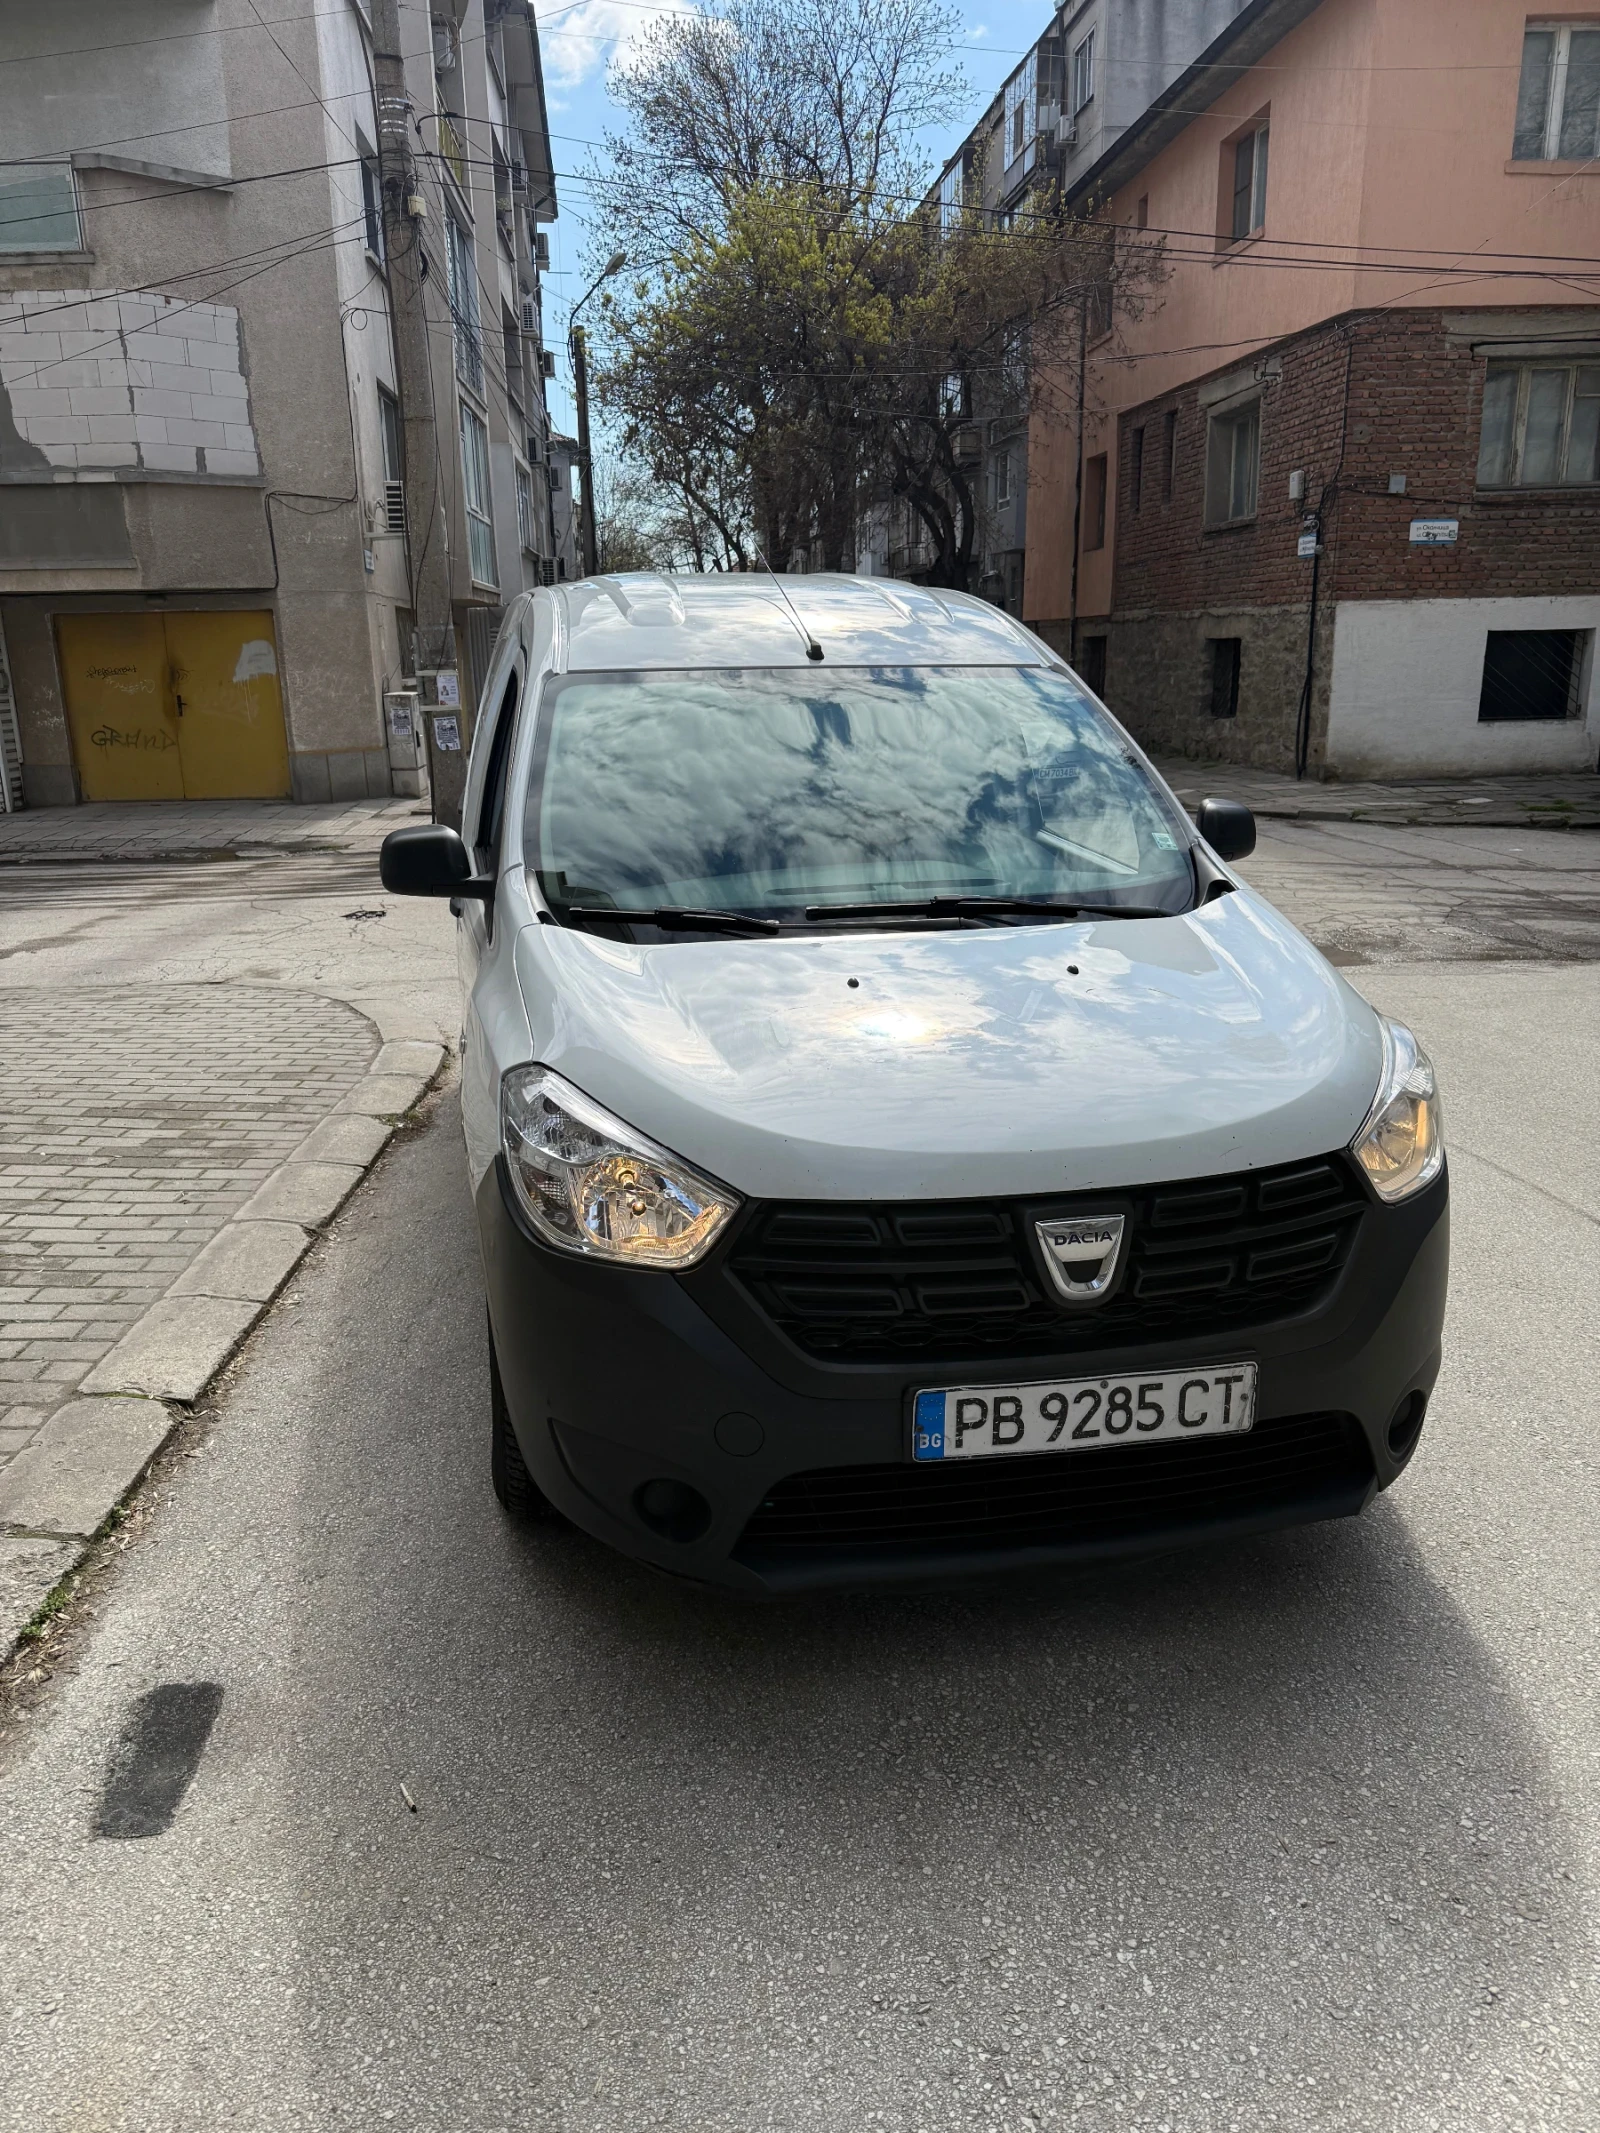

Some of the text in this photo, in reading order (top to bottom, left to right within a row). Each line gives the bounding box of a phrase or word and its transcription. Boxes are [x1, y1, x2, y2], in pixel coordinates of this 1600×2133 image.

[1054, 1230, 1113, 1246] DACIA
[955, 1374, 1244, 1449] PB 9285 CT
[918, 1433, 942, 1450] BG
